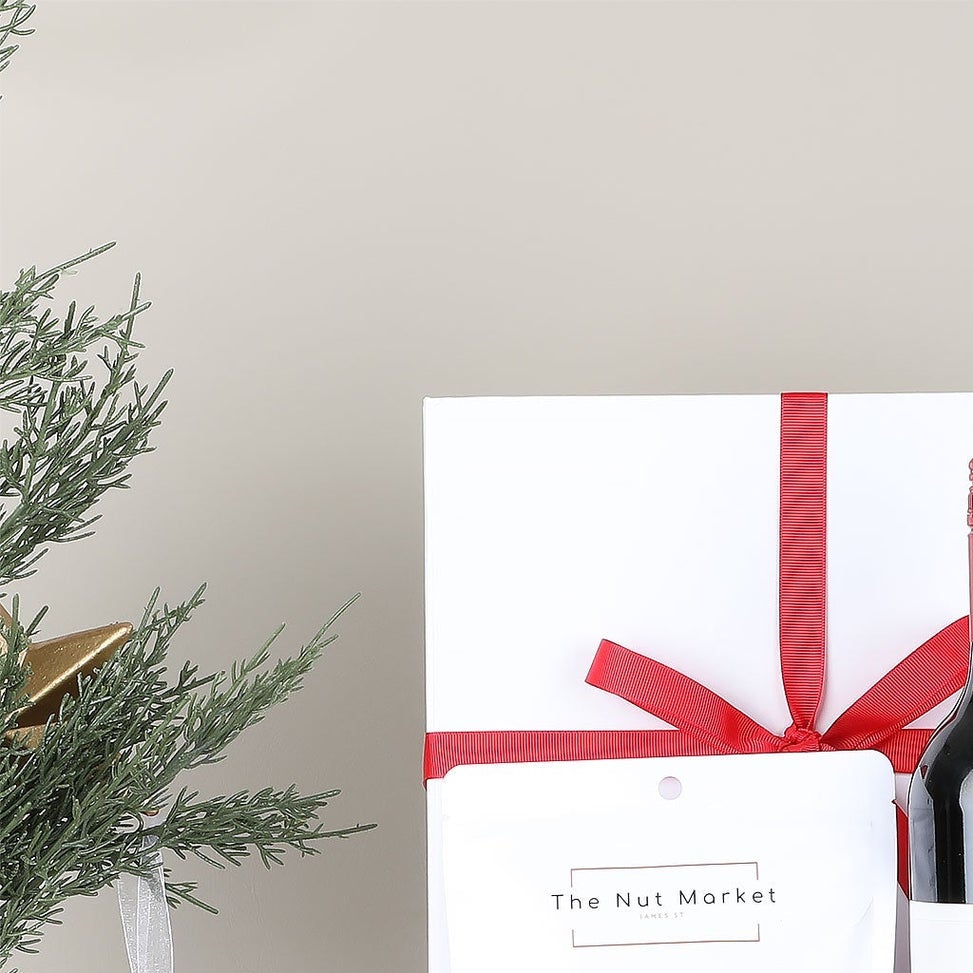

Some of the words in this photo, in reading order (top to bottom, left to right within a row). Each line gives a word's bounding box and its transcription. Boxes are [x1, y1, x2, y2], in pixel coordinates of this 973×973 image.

[551, 894, 600, 910] The
[616, 892, 663, 908] Nut
[679, 887, 776, 905] Market
